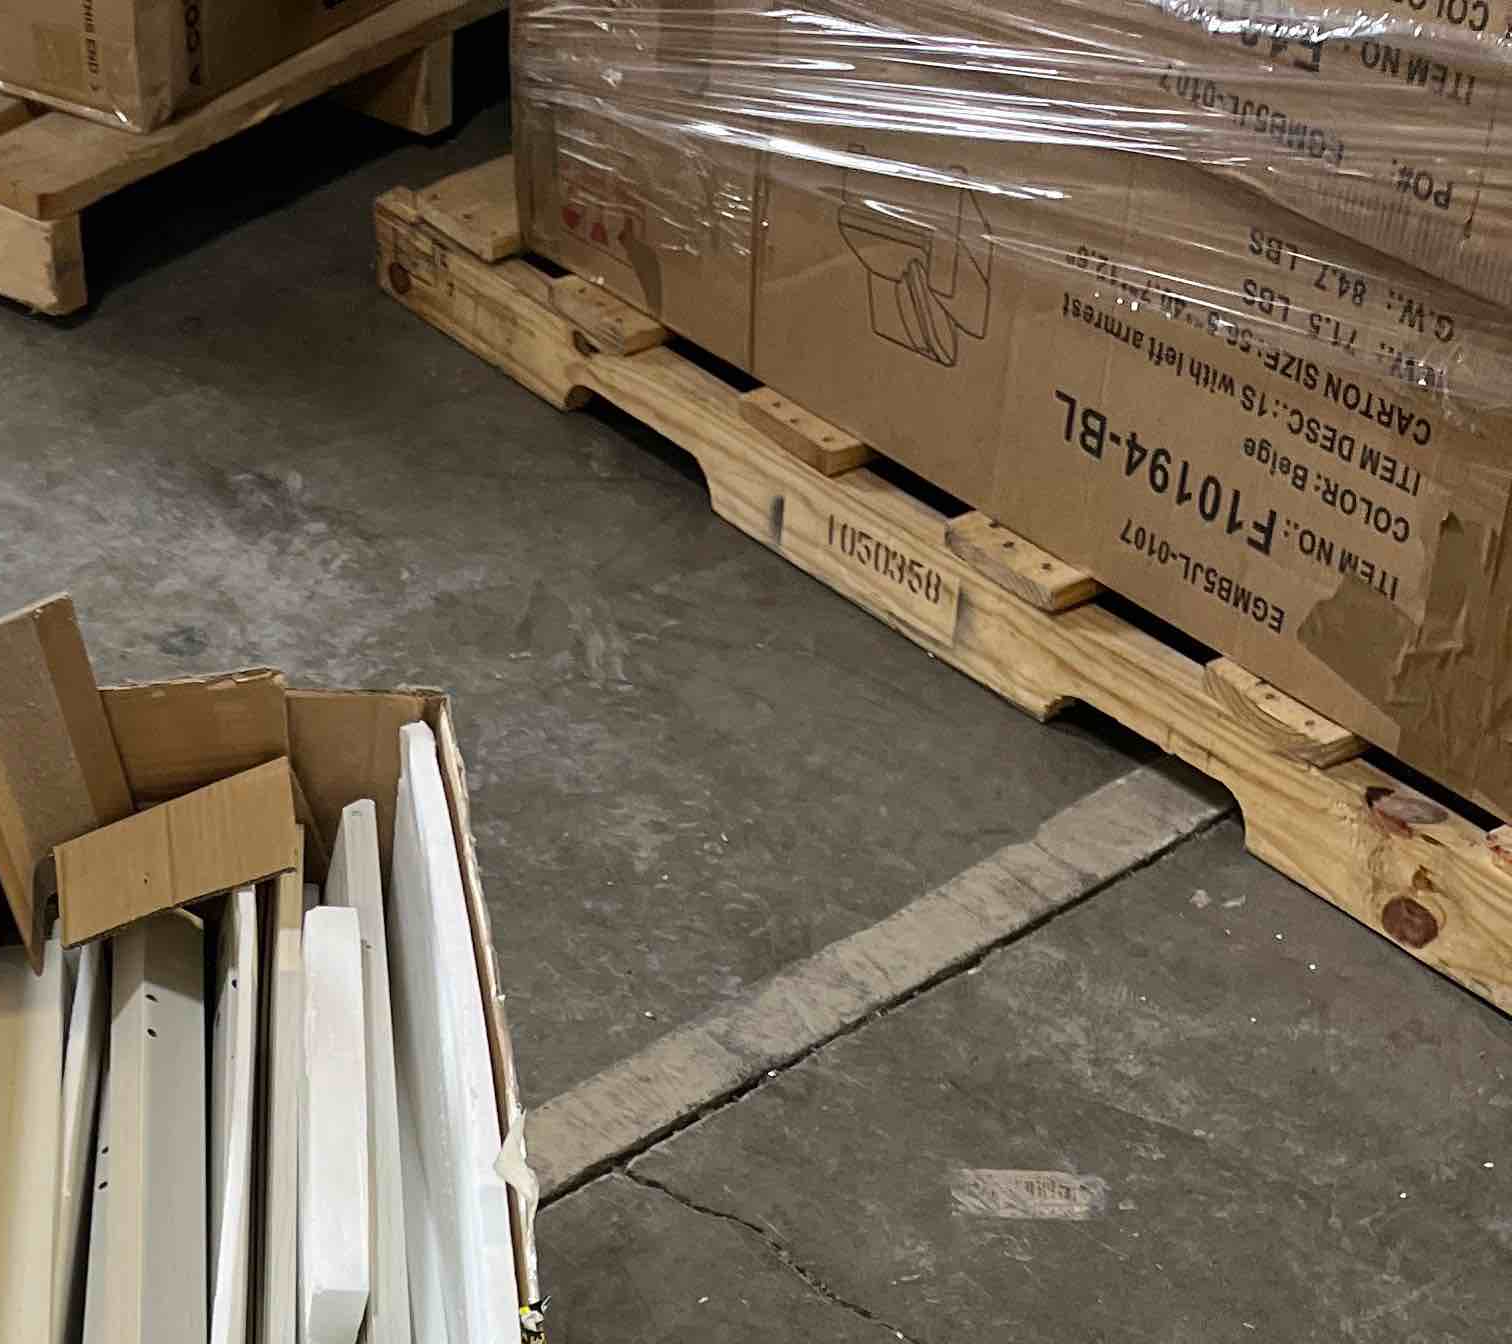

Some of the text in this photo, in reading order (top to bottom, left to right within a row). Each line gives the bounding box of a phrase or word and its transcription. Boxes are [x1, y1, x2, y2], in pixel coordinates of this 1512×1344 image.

[1248, 225, 1299, 272] LBS
[1062, 291, 1144, 351] armrest
[1148, 337, 1185, 376] left
[1188, 355, 1236, 393] with
[1322, 369, 1433, 446] CARTON
[1054, 388, 1278, 557] F10194-BL
[1242, 436, 1411, 543] COLOR: Beige
[1359, 442, 1422, 497] ITEM
[1120, 516, 1286, 634] EGMB5JL-0107
[1337, 541, 1399, 601] ITEM
